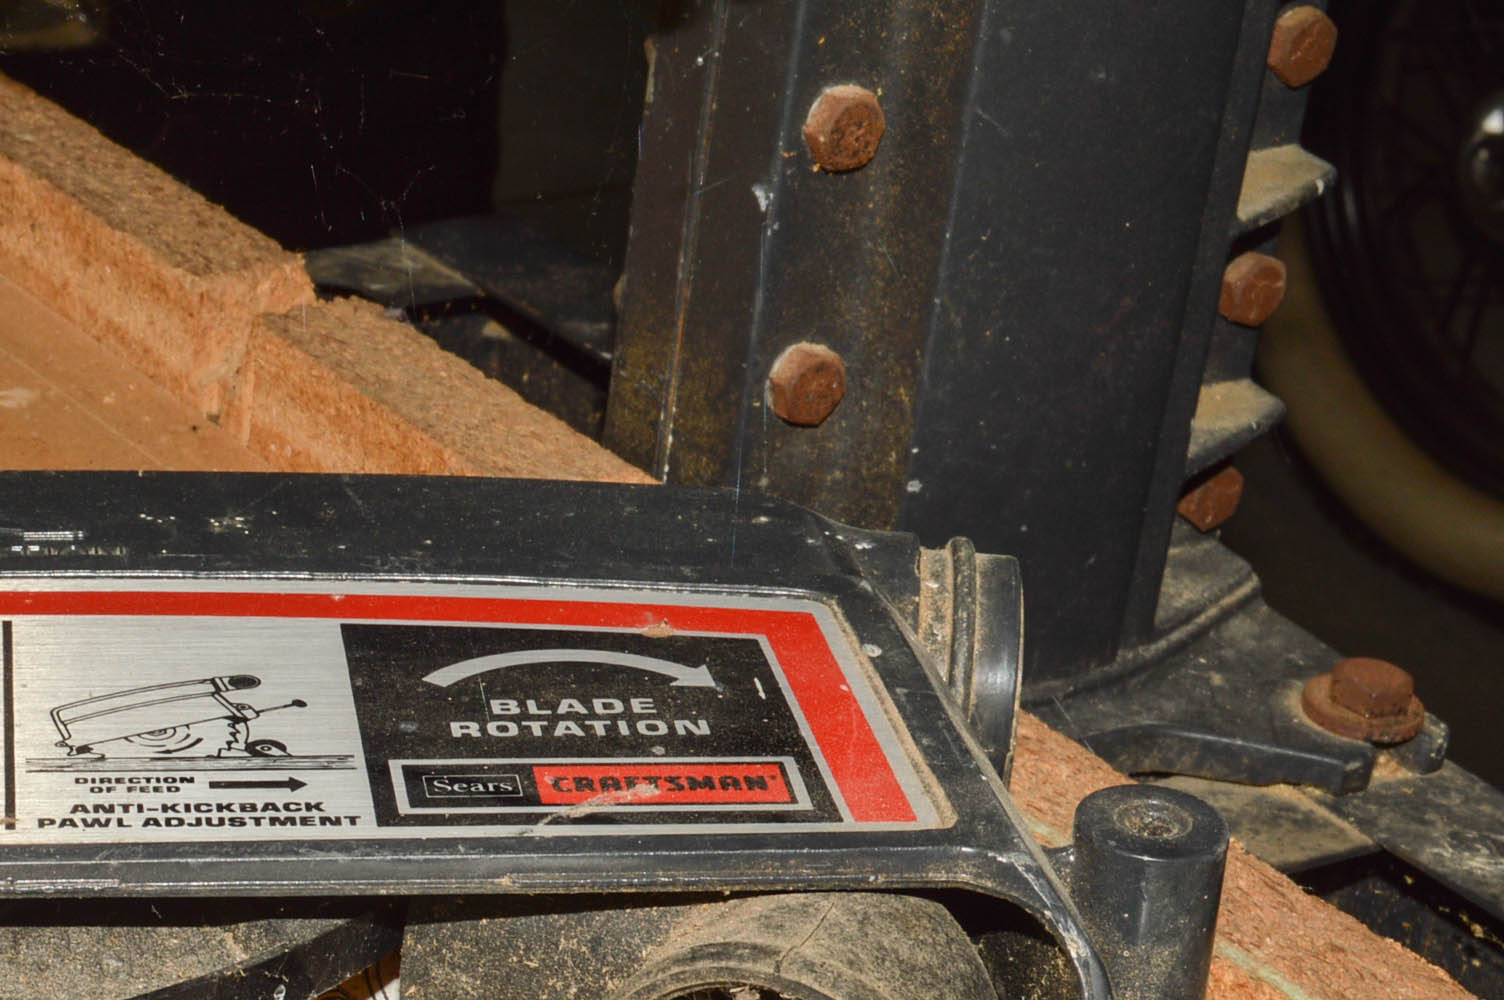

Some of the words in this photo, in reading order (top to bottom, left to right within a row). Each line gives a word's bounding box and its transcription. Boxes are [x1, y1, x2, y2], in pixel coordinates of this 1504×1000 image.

[488, 698, 657, 715] BLADE
[449, 719, 711, 738] ROTATION
[74, 776, 195, 785] DIRECTION
[431, 775, 514, 793] Sears
[551, 775, 770, 793] CRAFTSMAN
[89, 786, 121, 794] OF
[126, 785, 182, 793] FEED
[69, 801, 327, 814] ANTI-KICKBACK
[37, 817, 132, 829] PAWL
[141, 815, 362, 828] ADJUSTMENT
